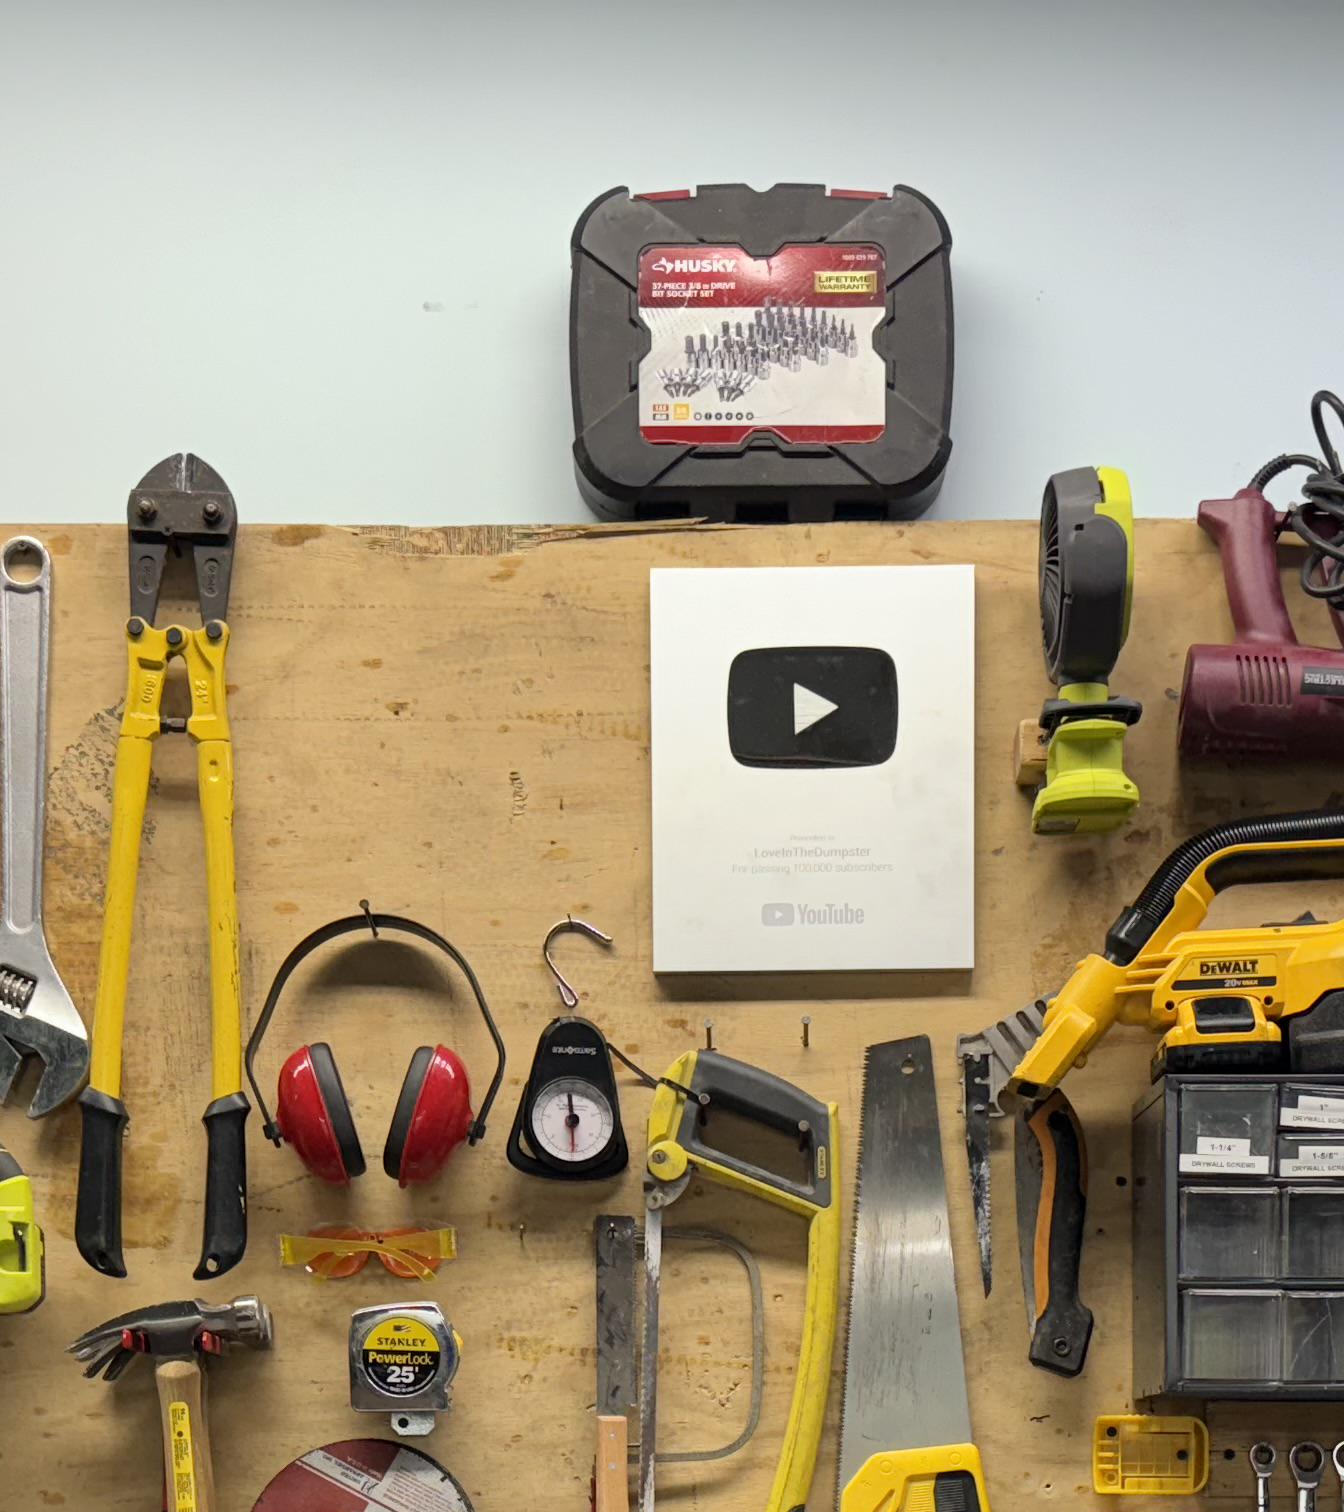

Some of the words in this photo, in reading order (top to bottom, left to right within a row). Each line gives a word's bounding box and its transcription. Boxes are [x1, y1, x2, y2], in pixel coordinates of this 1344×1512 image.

[674, 259, 736, 273] HUSKY
[818, 275, 871, 283] LIFETIME
[710, 281, 736, 290] DRIVE
[818, 283, 871, 291] WARRANTY
[666, 290, 699, 298] SOCKET
[753, 847, 872, 859] LoveInTheDumpster
[835, 862, 894, 872] subscribers
[797, 903, 865, 925] YouTube
[1199, 959, 1259, 975] DEWALT
[376, 1337, 427, 1347] STANLEY
[368, 1352, 434, 1366] PowerLock
[386, 1366, 419, 1384] 25'
